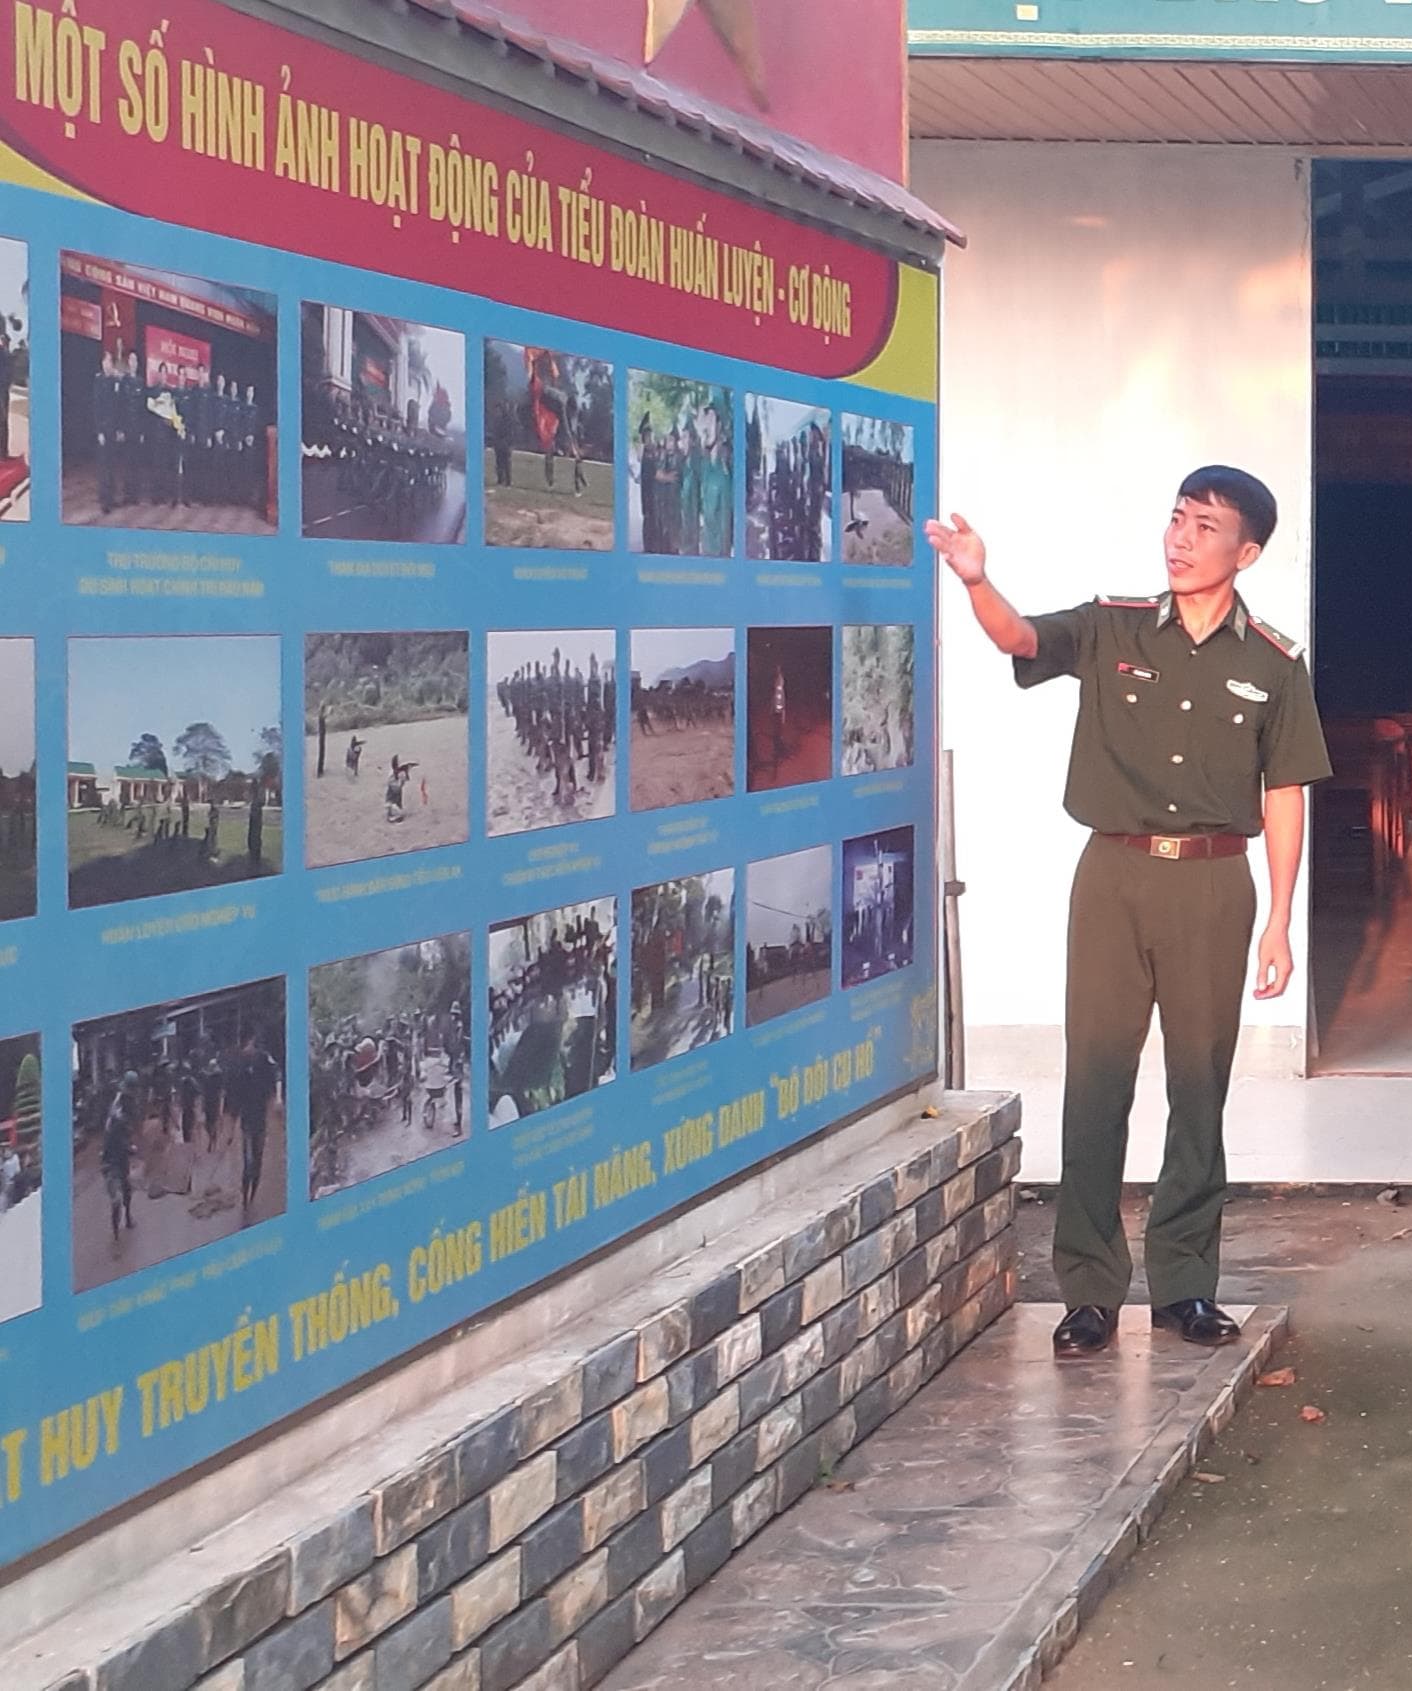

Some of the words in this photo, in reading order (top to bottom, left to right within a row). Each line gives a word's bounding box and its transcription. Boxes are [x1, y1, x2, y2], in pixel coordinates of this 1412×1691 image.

[15, 0, 106, 140] MỘT
[118, 18, 170, 143] SỐ
[181, 46, 265, 172] HÌNH
[275, 64, 340, 193] ẢNH
[350, 116, 422, 228] HOẠT
[428, 133, 499, 244] ĐỘNG
[506, 150, 554, 253] CỦA
[558, 167, 605, 268] TIỂU
[610, 200, 665, 286] ĐOÀN
[669, 212, 719, 300] HUẤN
[723, 240, 774, 327] LUYỆN
[778, 286, 786, 301] -
[788, 263, 811, 326] CƠ
[812, 264, 852, 345] ĐỘNG
[39, 1385, 124, 1486] HUY
[288, 1259, 400, 1361] THỐNG,
[408, 1217, 484, 1303] CỐNG
[488, 1180, 547, 1262] HIẾN
[553, 1166, 587, 1231] TÀI
[593, 1140, 657, 1210] NĂNG,
[663, 1113, 714, 1176] XỨNG
[718, 1089, 765, 1149] DANH
